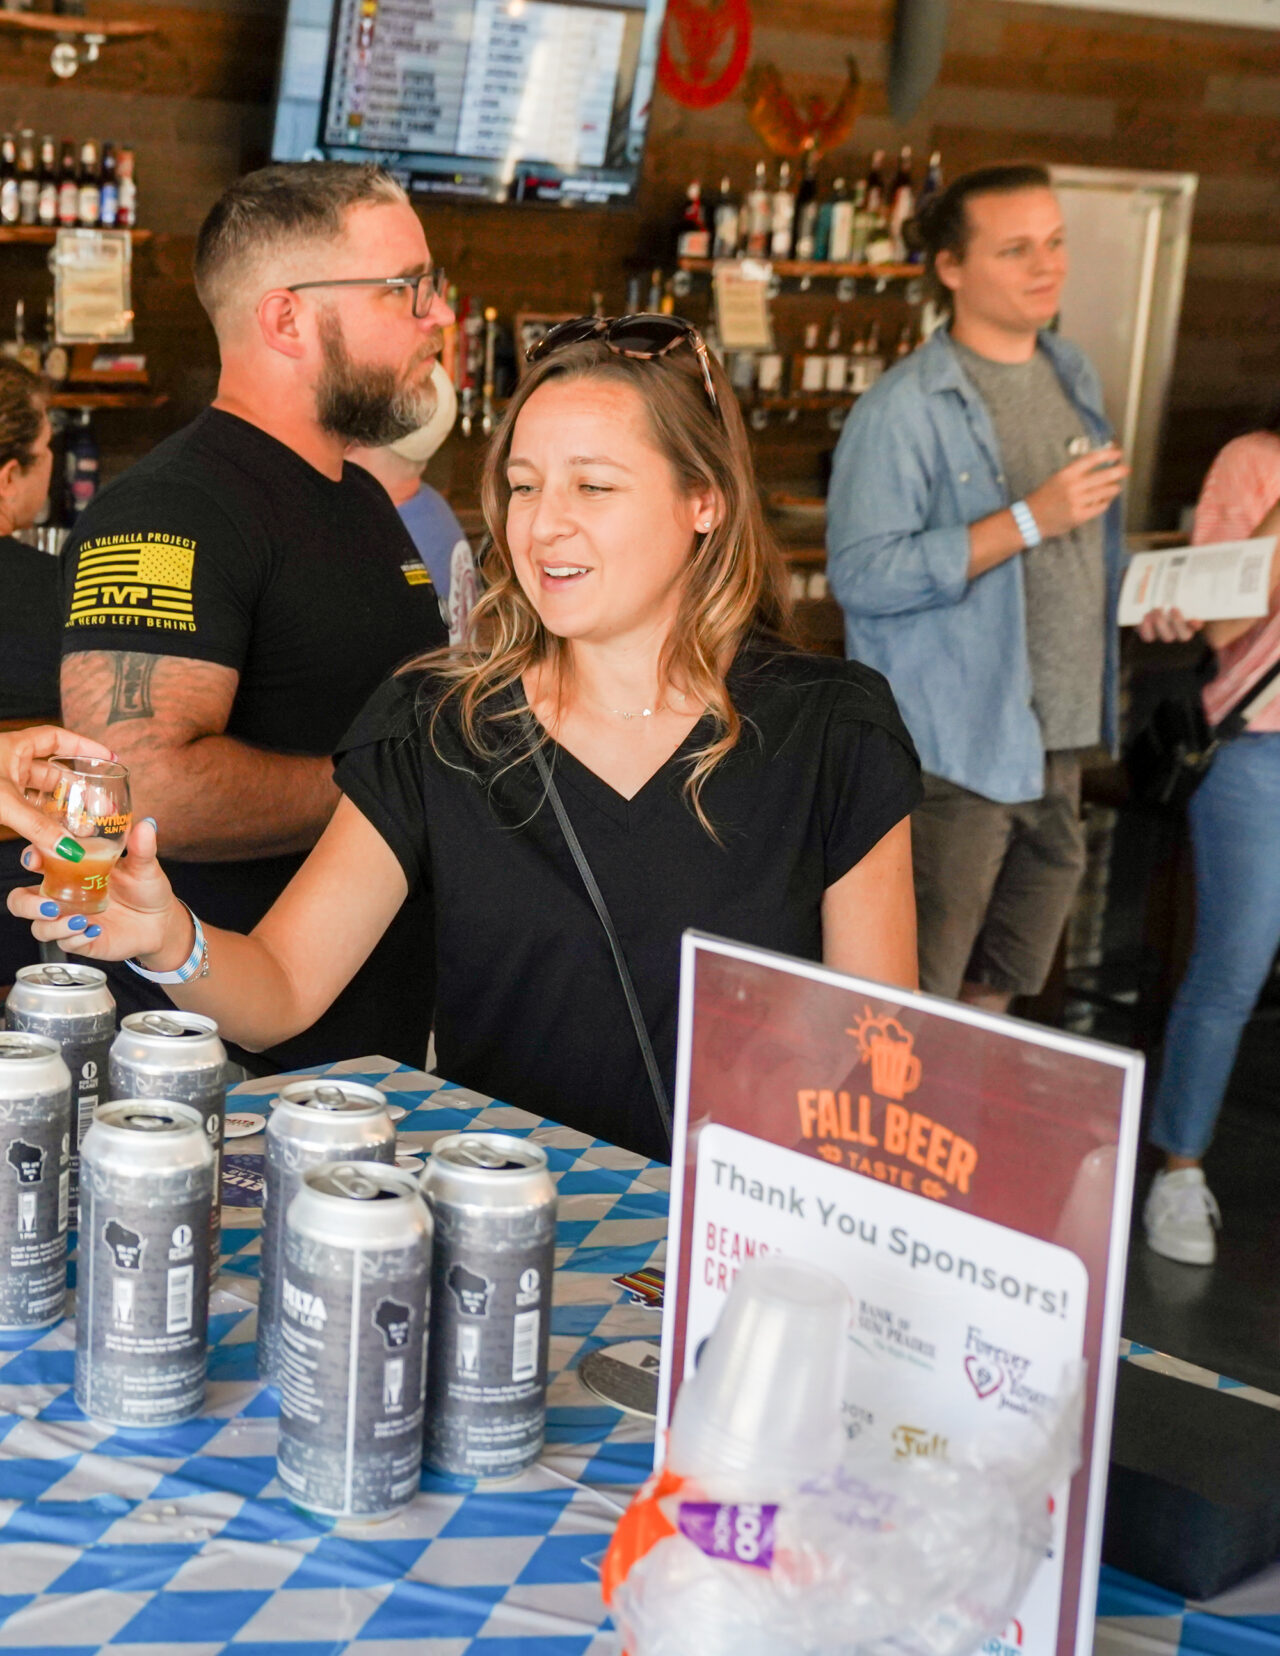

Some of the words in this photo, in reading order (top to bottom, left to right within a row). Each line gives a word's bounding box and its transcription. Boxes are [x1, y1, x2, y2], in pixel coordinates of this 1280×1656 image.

[95, 533, 142, 547] VALHALLA
[147, 532, 197, 550] PROJECT
[100, 585, 148, 605] TVP
[78, 615, 107, 626] HERO
[112, 615, 140, 626] LEFT
[146, 618, 197, 632] BEHIND
[797, 1089, 878, 1147] FALL
[884, 1103, 978, 1194] BEER
[848, 1152, 913, 1192] TASTE
[711, 1159, 806, 1218] Thank
[815, 1197, 878, 1246] You
[889, 1228, 1068, 1319] Sponsors!
